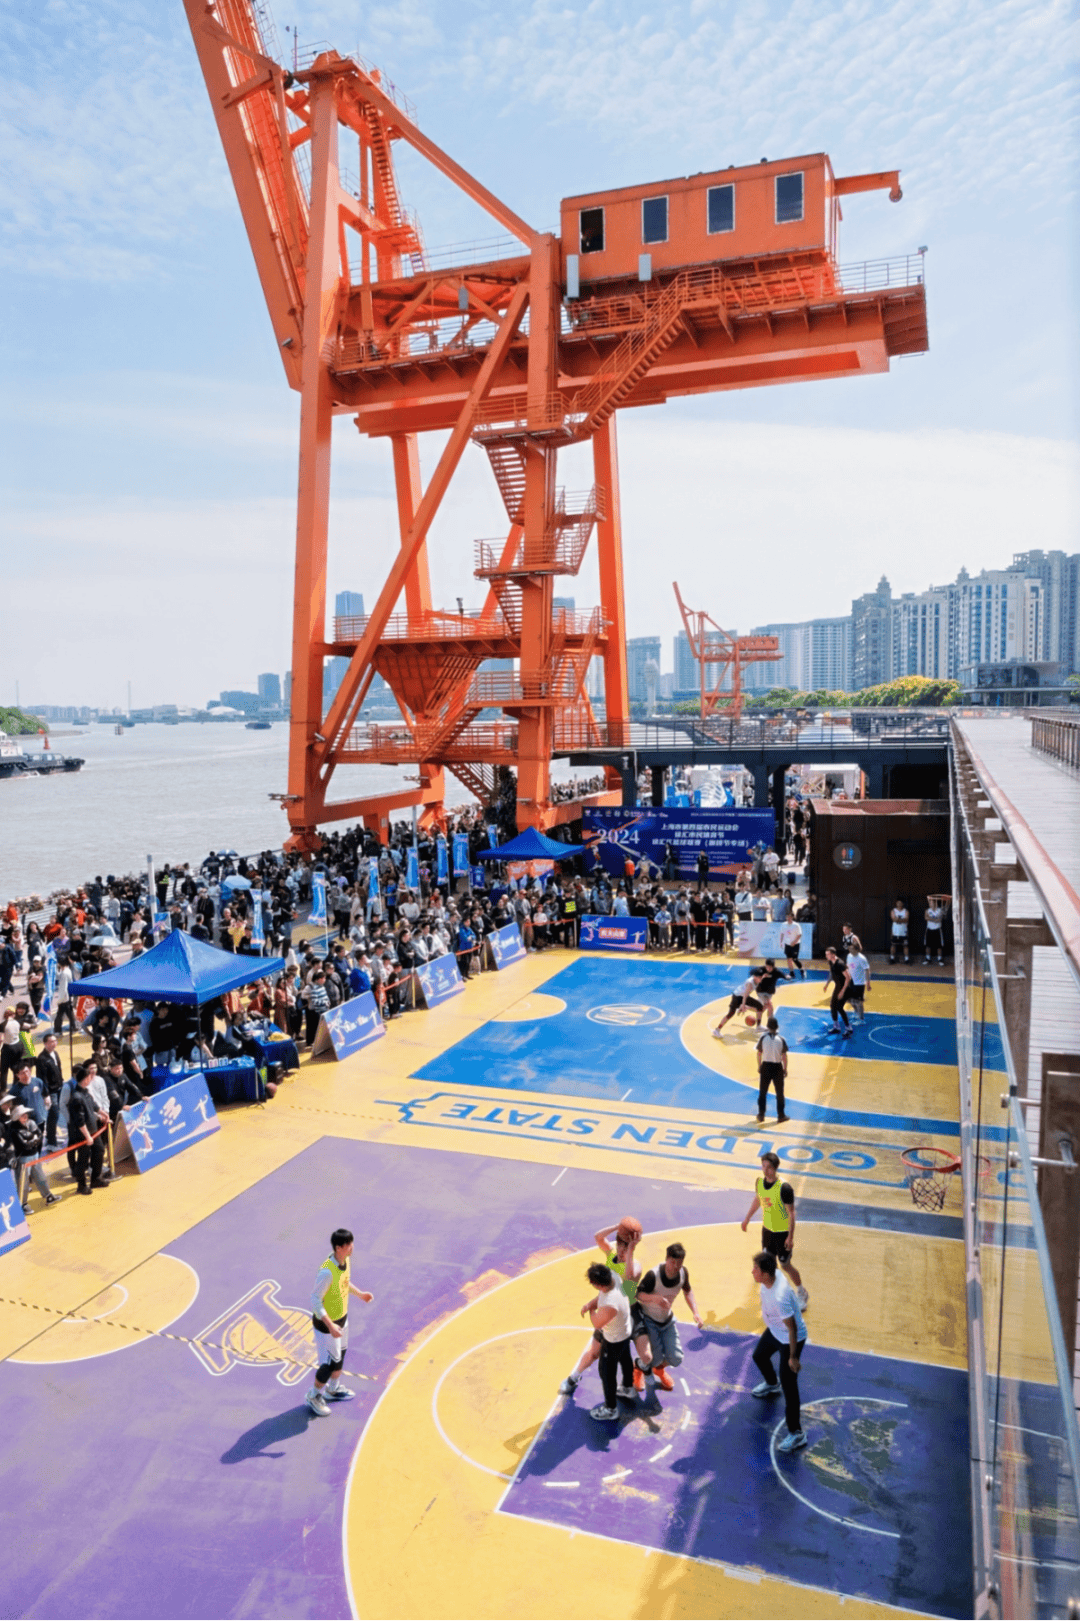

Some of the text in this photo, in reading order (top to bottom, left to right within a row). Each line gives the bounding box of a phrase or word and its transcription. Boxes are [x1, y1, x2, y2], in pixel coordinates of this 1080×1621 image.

[597, 828, 641, 844] 2024
[440, 1103, 877, 1170] GOLDEN STATE
